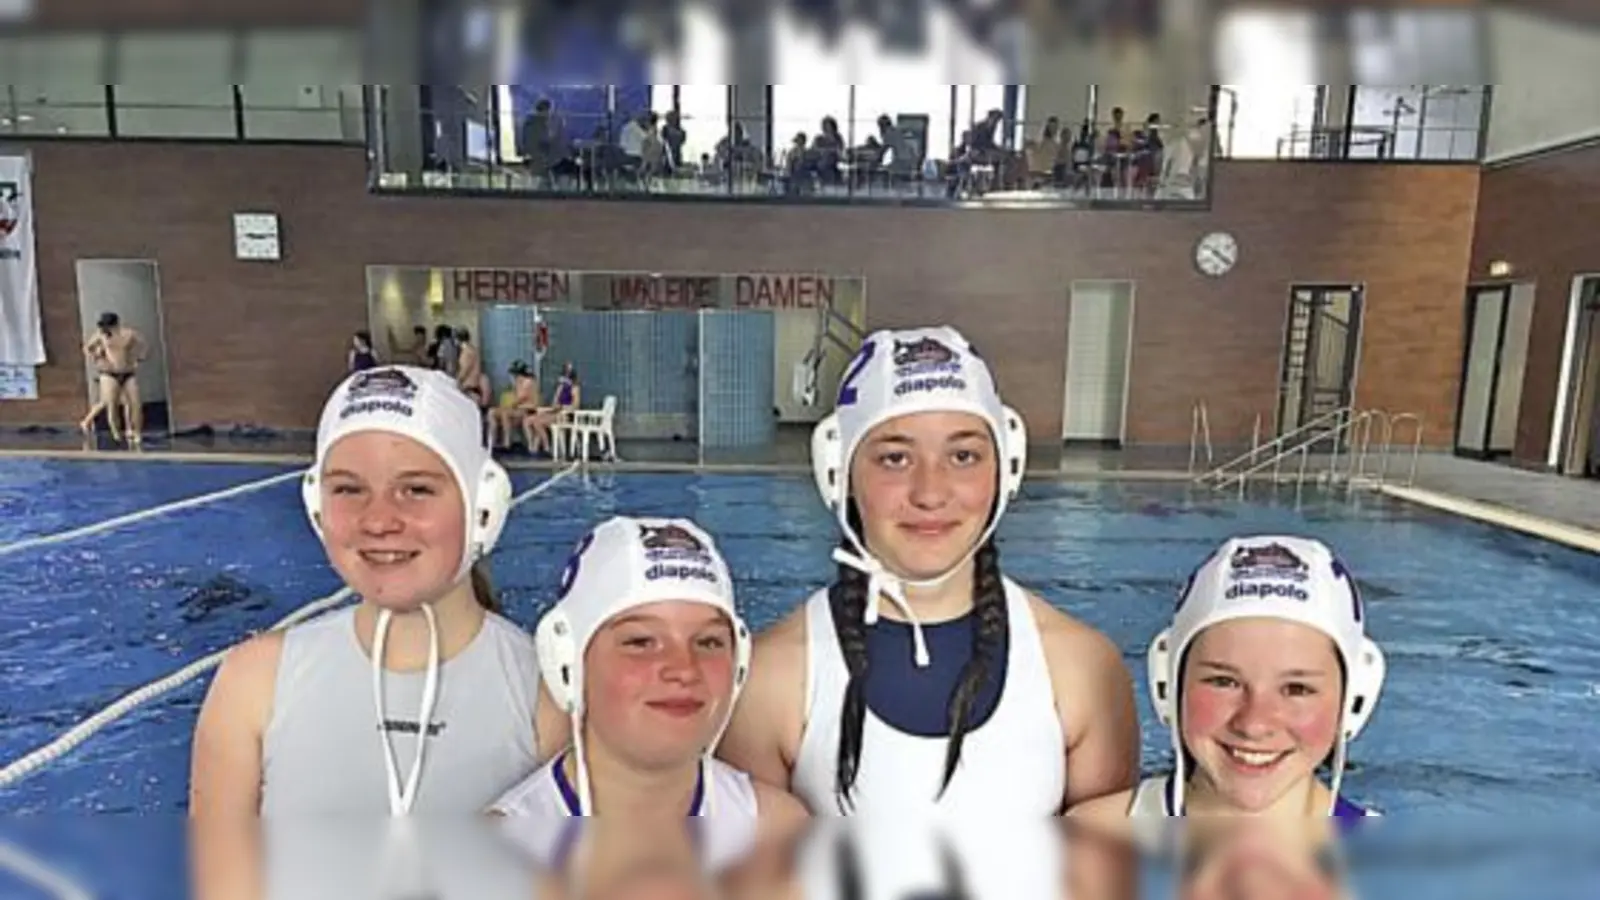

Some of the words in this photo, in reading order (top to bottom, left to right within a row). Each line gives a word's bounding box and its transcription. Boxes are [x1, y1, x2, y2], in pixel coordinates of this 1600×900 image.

[453, 269, 570, 303] HERREN
[610, 274, 714, 307] UMKLEIDE
[735, 275, 835, 309] DAMEN
[837, 341, 876, 405] 2
[894, 375, 967, 396] diapolo
[644, 563, 718, 583] diapolo
[1224, 582, 1310, 601] diapolo
